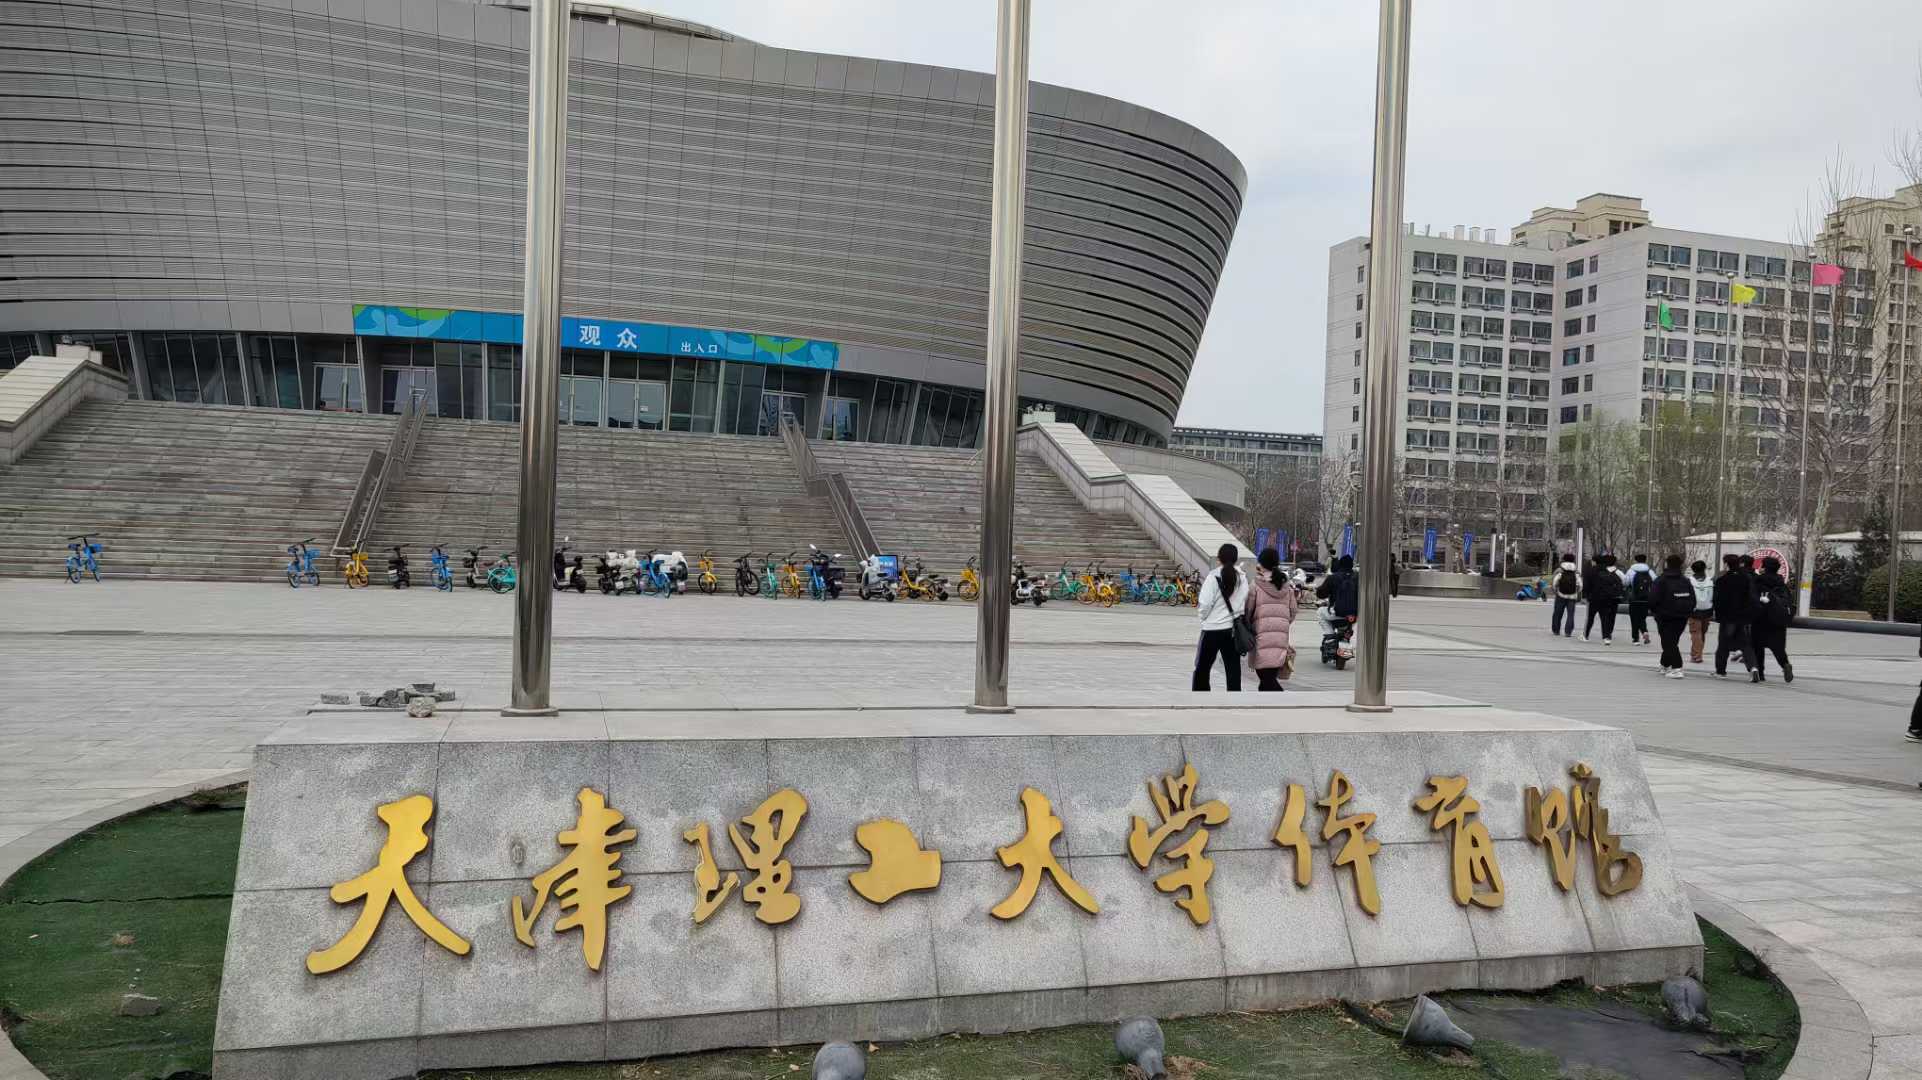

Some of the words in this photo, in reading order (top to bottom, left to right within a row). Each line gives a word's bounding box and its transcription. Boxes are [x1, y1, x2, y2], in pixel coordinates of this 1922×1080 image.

[579, 324, 638, 349] 观众
[680, 341, 718, 353] 出入口
[306, 762, 1644, 976] 天津理工大学体育馆
